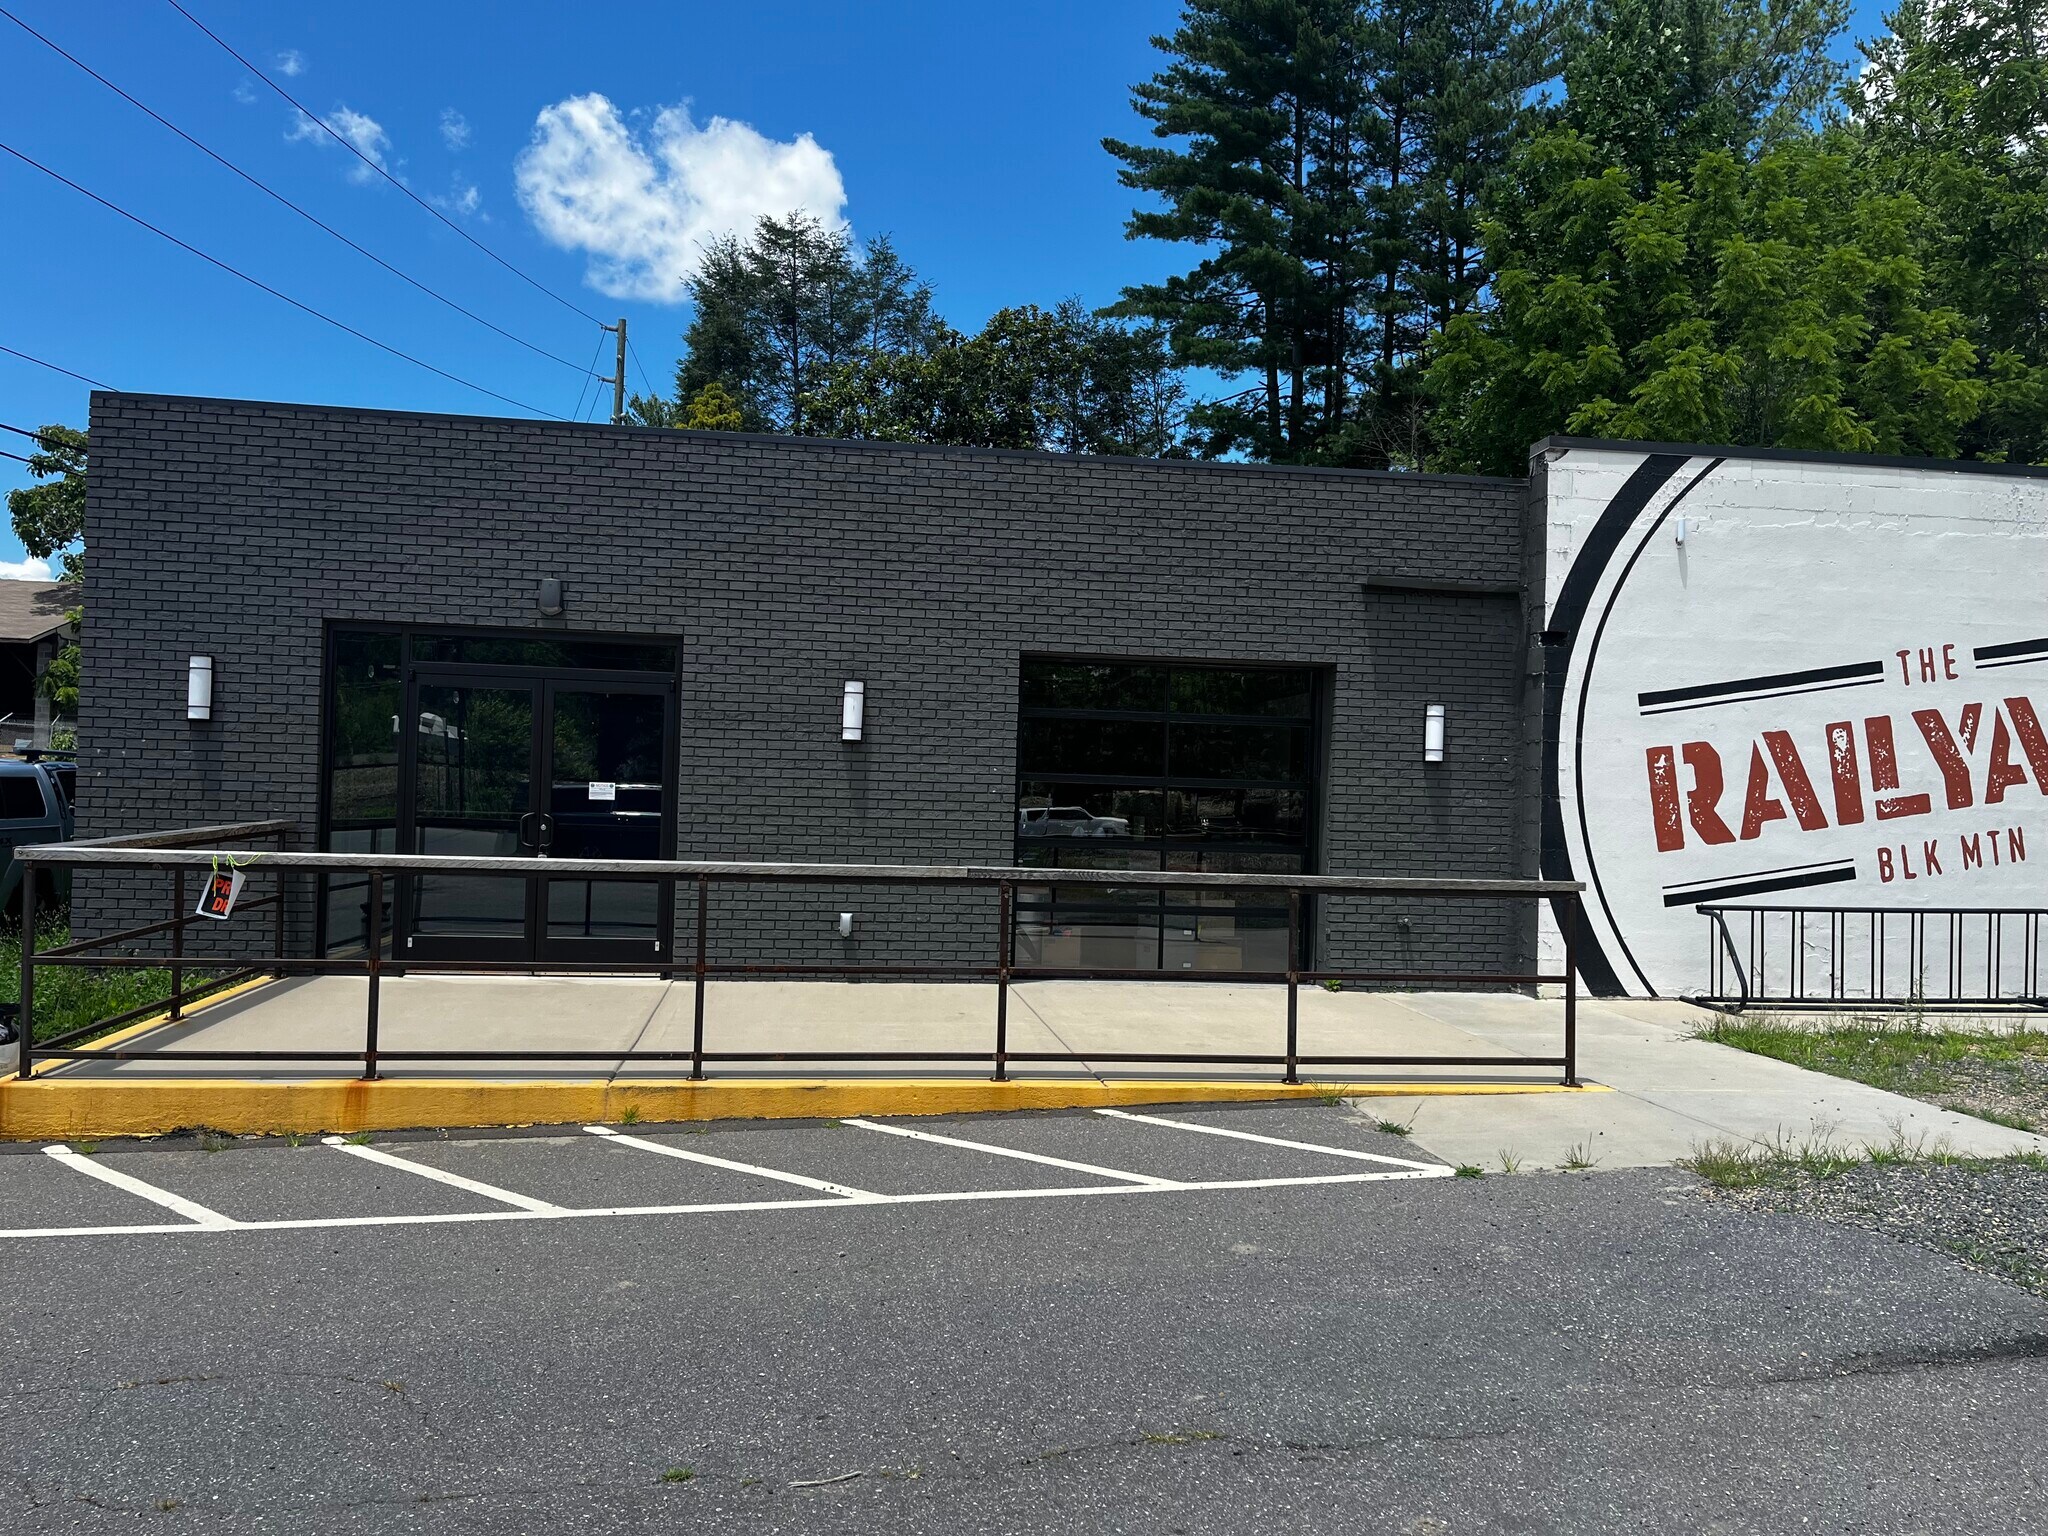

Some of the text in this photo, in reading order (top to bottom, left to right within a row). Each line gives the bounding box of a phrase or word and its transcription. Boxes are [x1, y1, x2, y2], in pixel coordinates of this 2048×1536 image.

[1896, 643, 1959, 686] THE
[1645, 696, 2048, 852] RAILYA
[1877, 826, 2026, 883] BLK MTN
